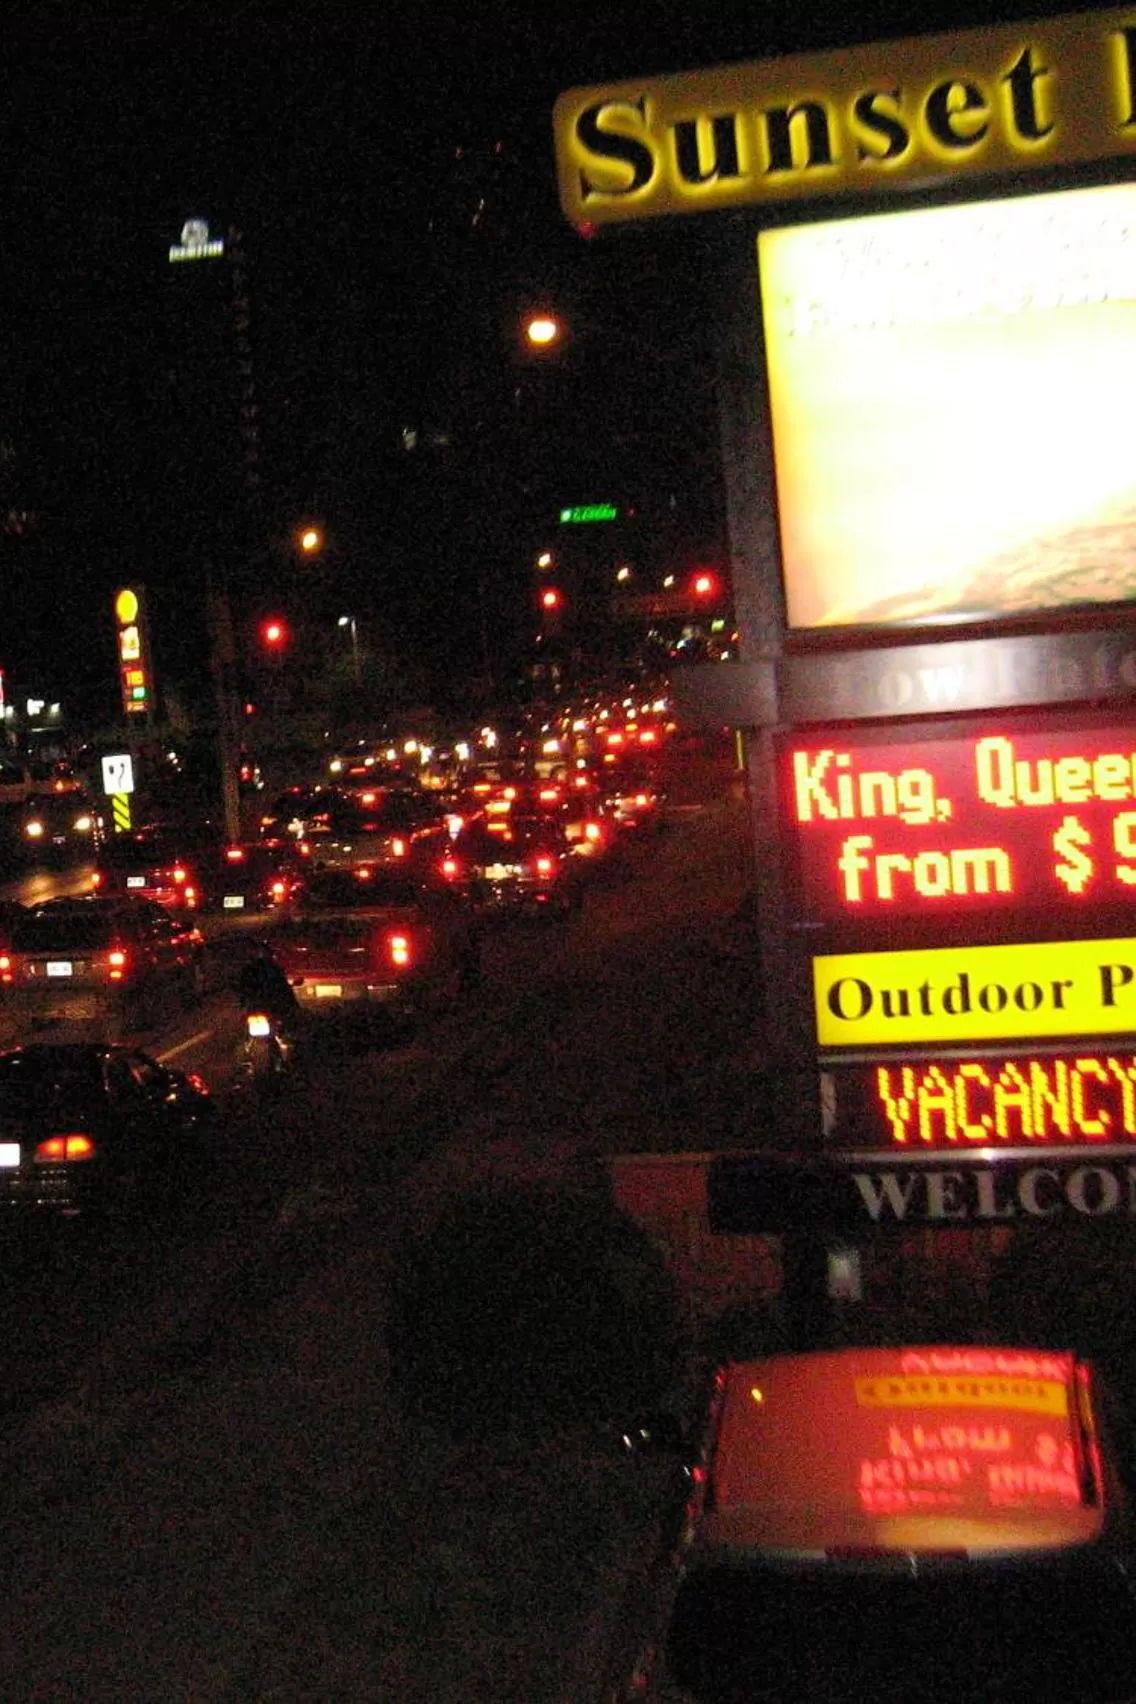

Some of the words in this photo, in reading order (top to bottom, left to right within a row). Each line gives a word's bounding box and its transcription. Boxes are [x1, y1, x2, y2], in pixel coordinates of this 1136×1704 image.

[575, 46, 1055, 202] Sunset
[793, 750, 953, 824] King,
[839, 836, 1012, 902] from
[827, 973, 1073, 1021] Outdoor
[851, 1166, 1136, 1221] WELCO
